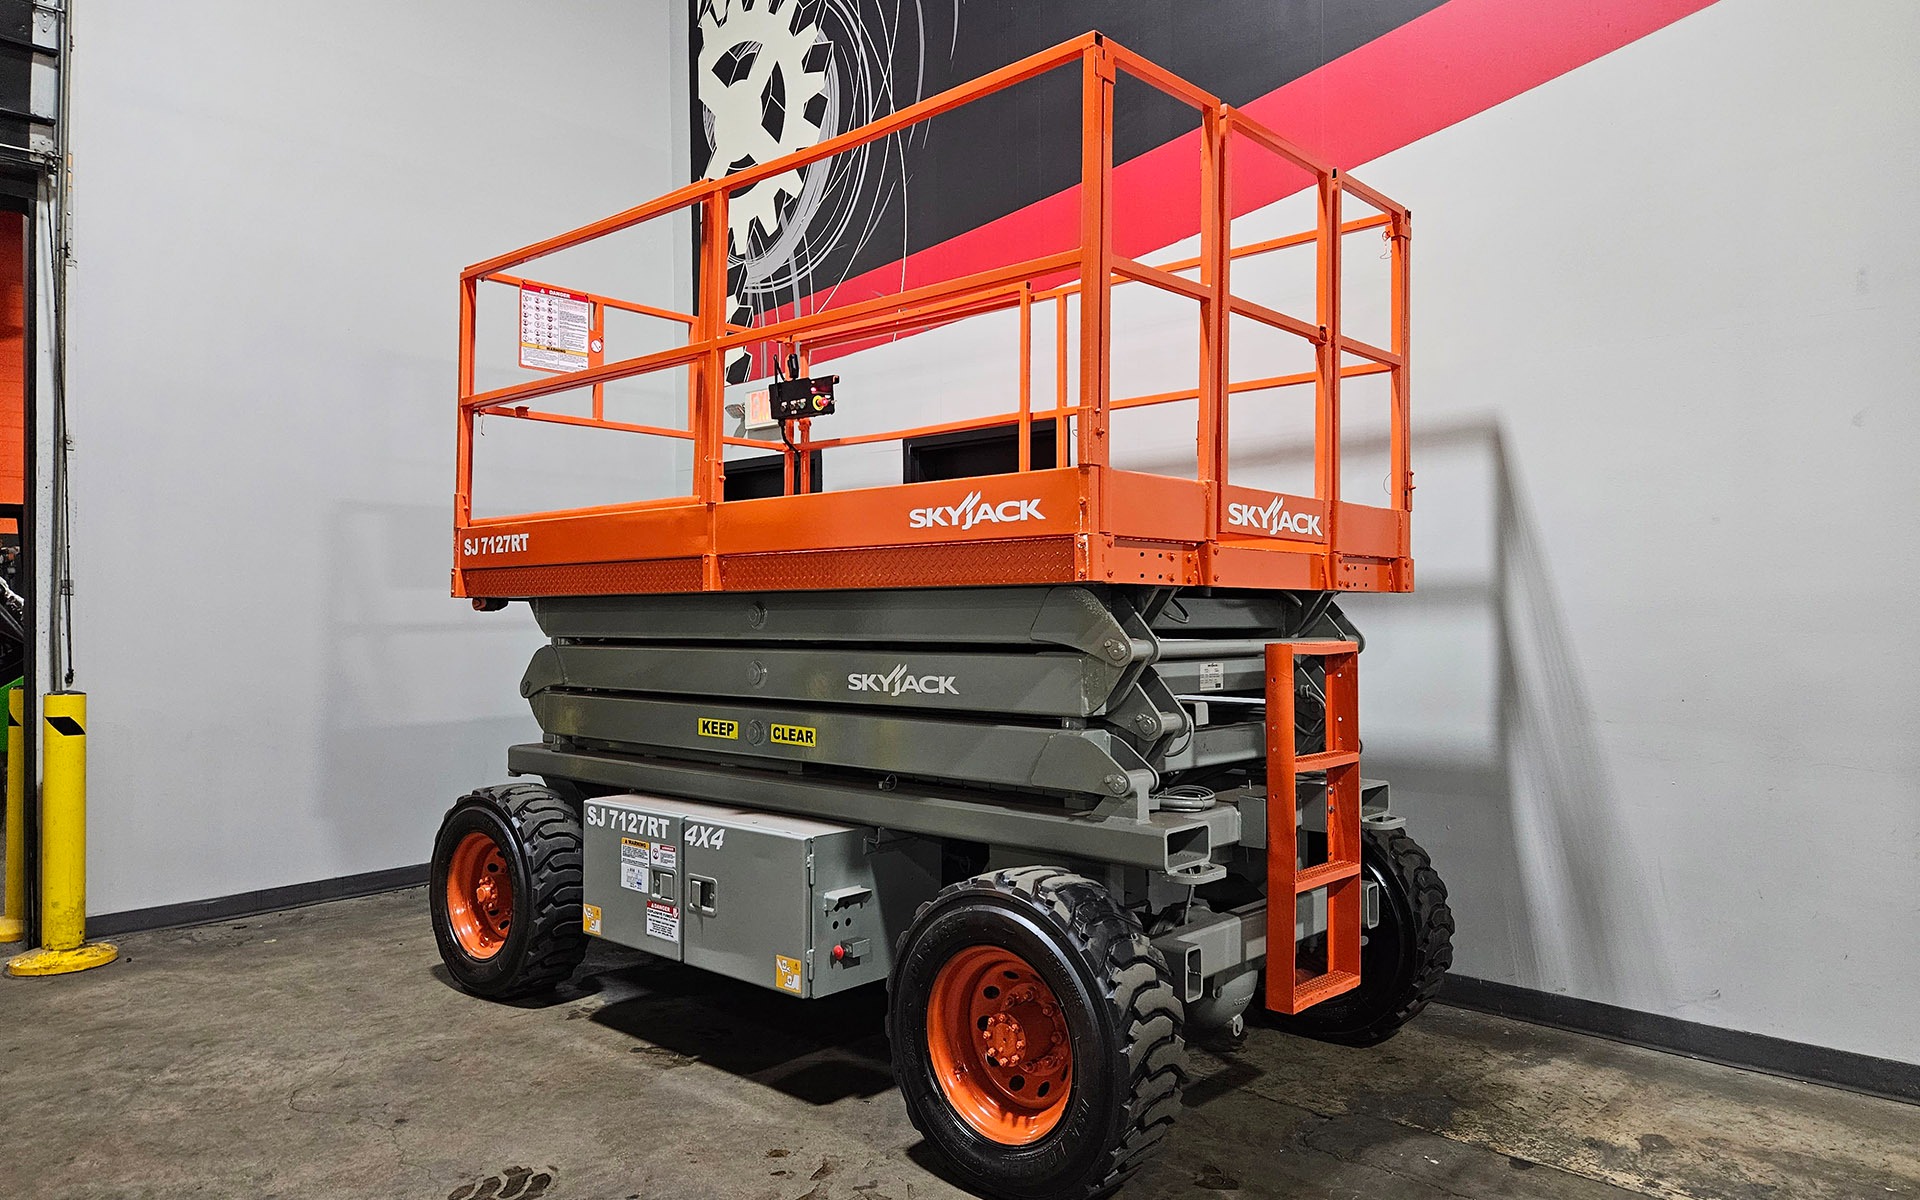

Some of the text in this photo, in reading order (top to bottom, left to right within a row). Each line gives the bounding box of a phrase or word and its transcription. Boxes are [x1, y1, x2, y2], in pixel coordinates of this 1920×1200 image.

[548, 290, 571, 299] DANGER
[909, 490, 1046, 530] SKYJACK
[1228, 495, 1323, 535] SKYJACK
[464, 533, 529, 556] SJ 7127RT
[847, 663, 960, 697] SKYJACK
[701, 720, 814, 744] KEEP CLEAR
[587, 805, 670, 839] SJ 7127RT
[684, 825, 726, 850] 4X4
